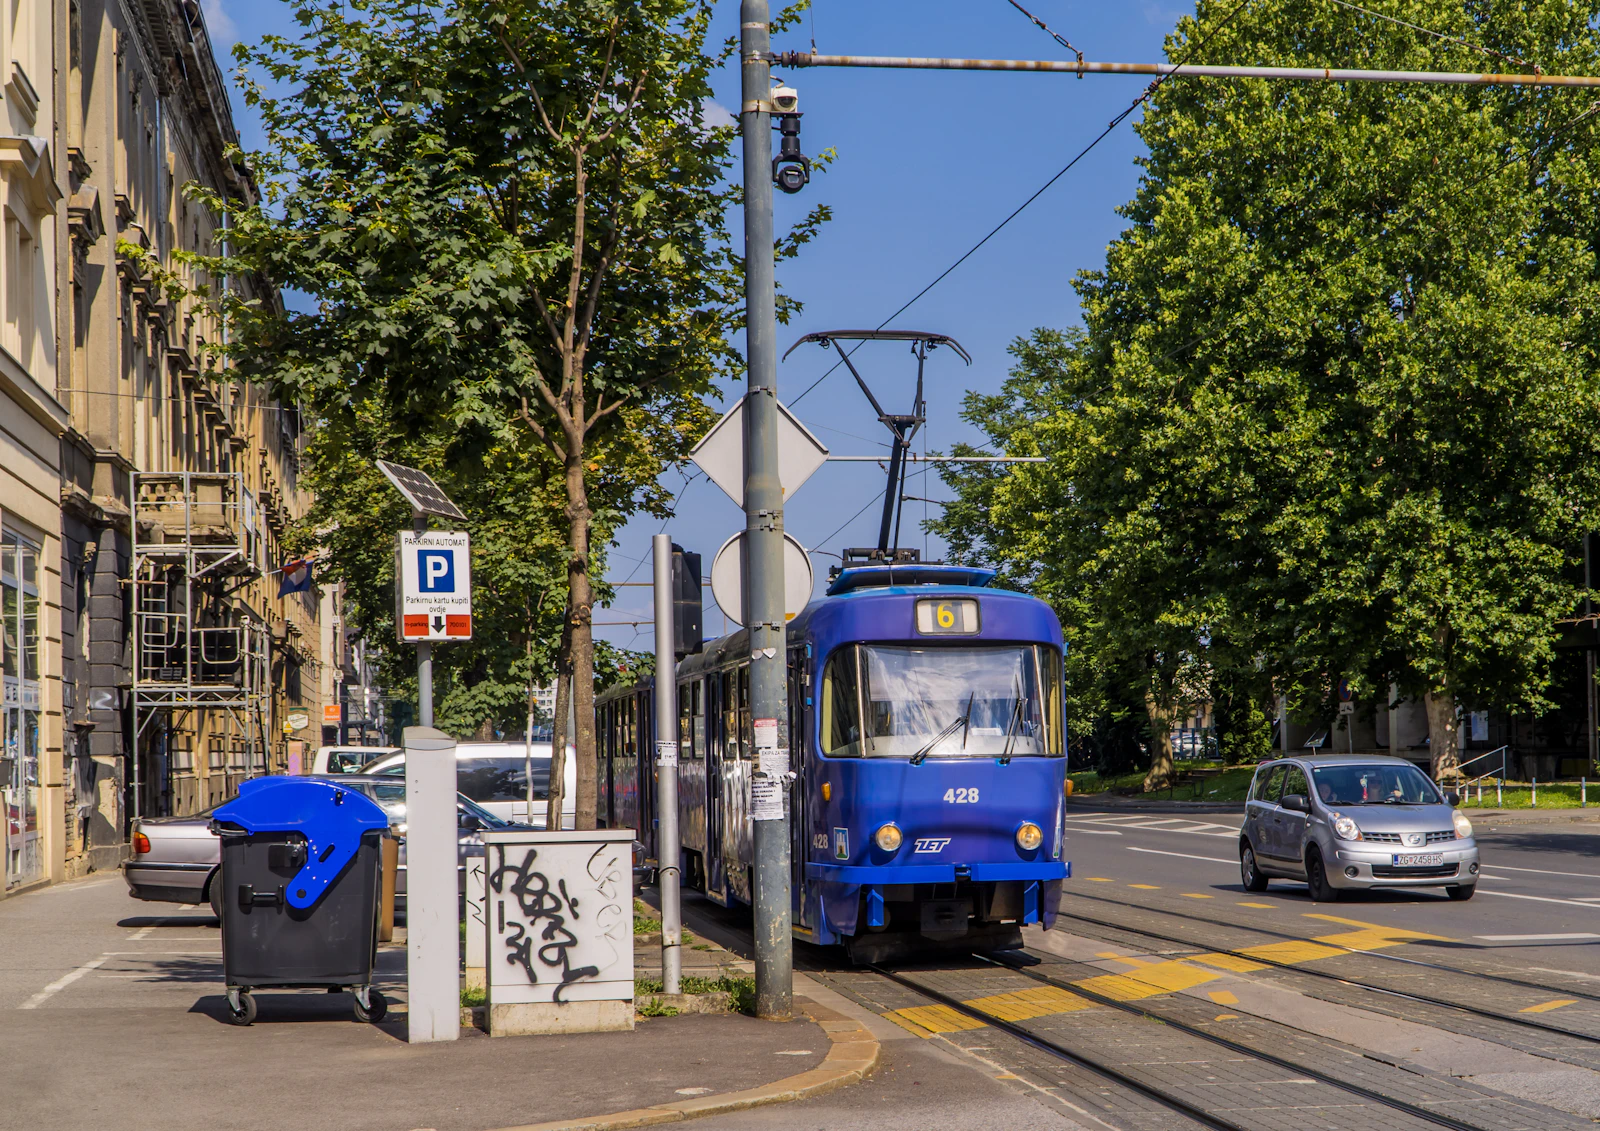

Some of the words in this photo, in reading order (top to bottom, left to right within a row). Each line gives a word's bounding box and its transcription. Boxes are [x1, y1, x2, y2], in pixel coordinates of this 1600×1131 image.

[404, 537, 434, 546] PARKIRNI
[426, 555, 449, 588] P
[406, 596, 432, 604] Parkirnu
[433, 596, 450, 604] kartu
[451, 597, 468, 605] kupiti
[429, 605, 446, 614] ovdje
[937, 602, 955, 628] 6
[943, 787, 979, 804] 428
[813, 833, 829, 849] 428
[1400, 856, 1409, 864] ZG
